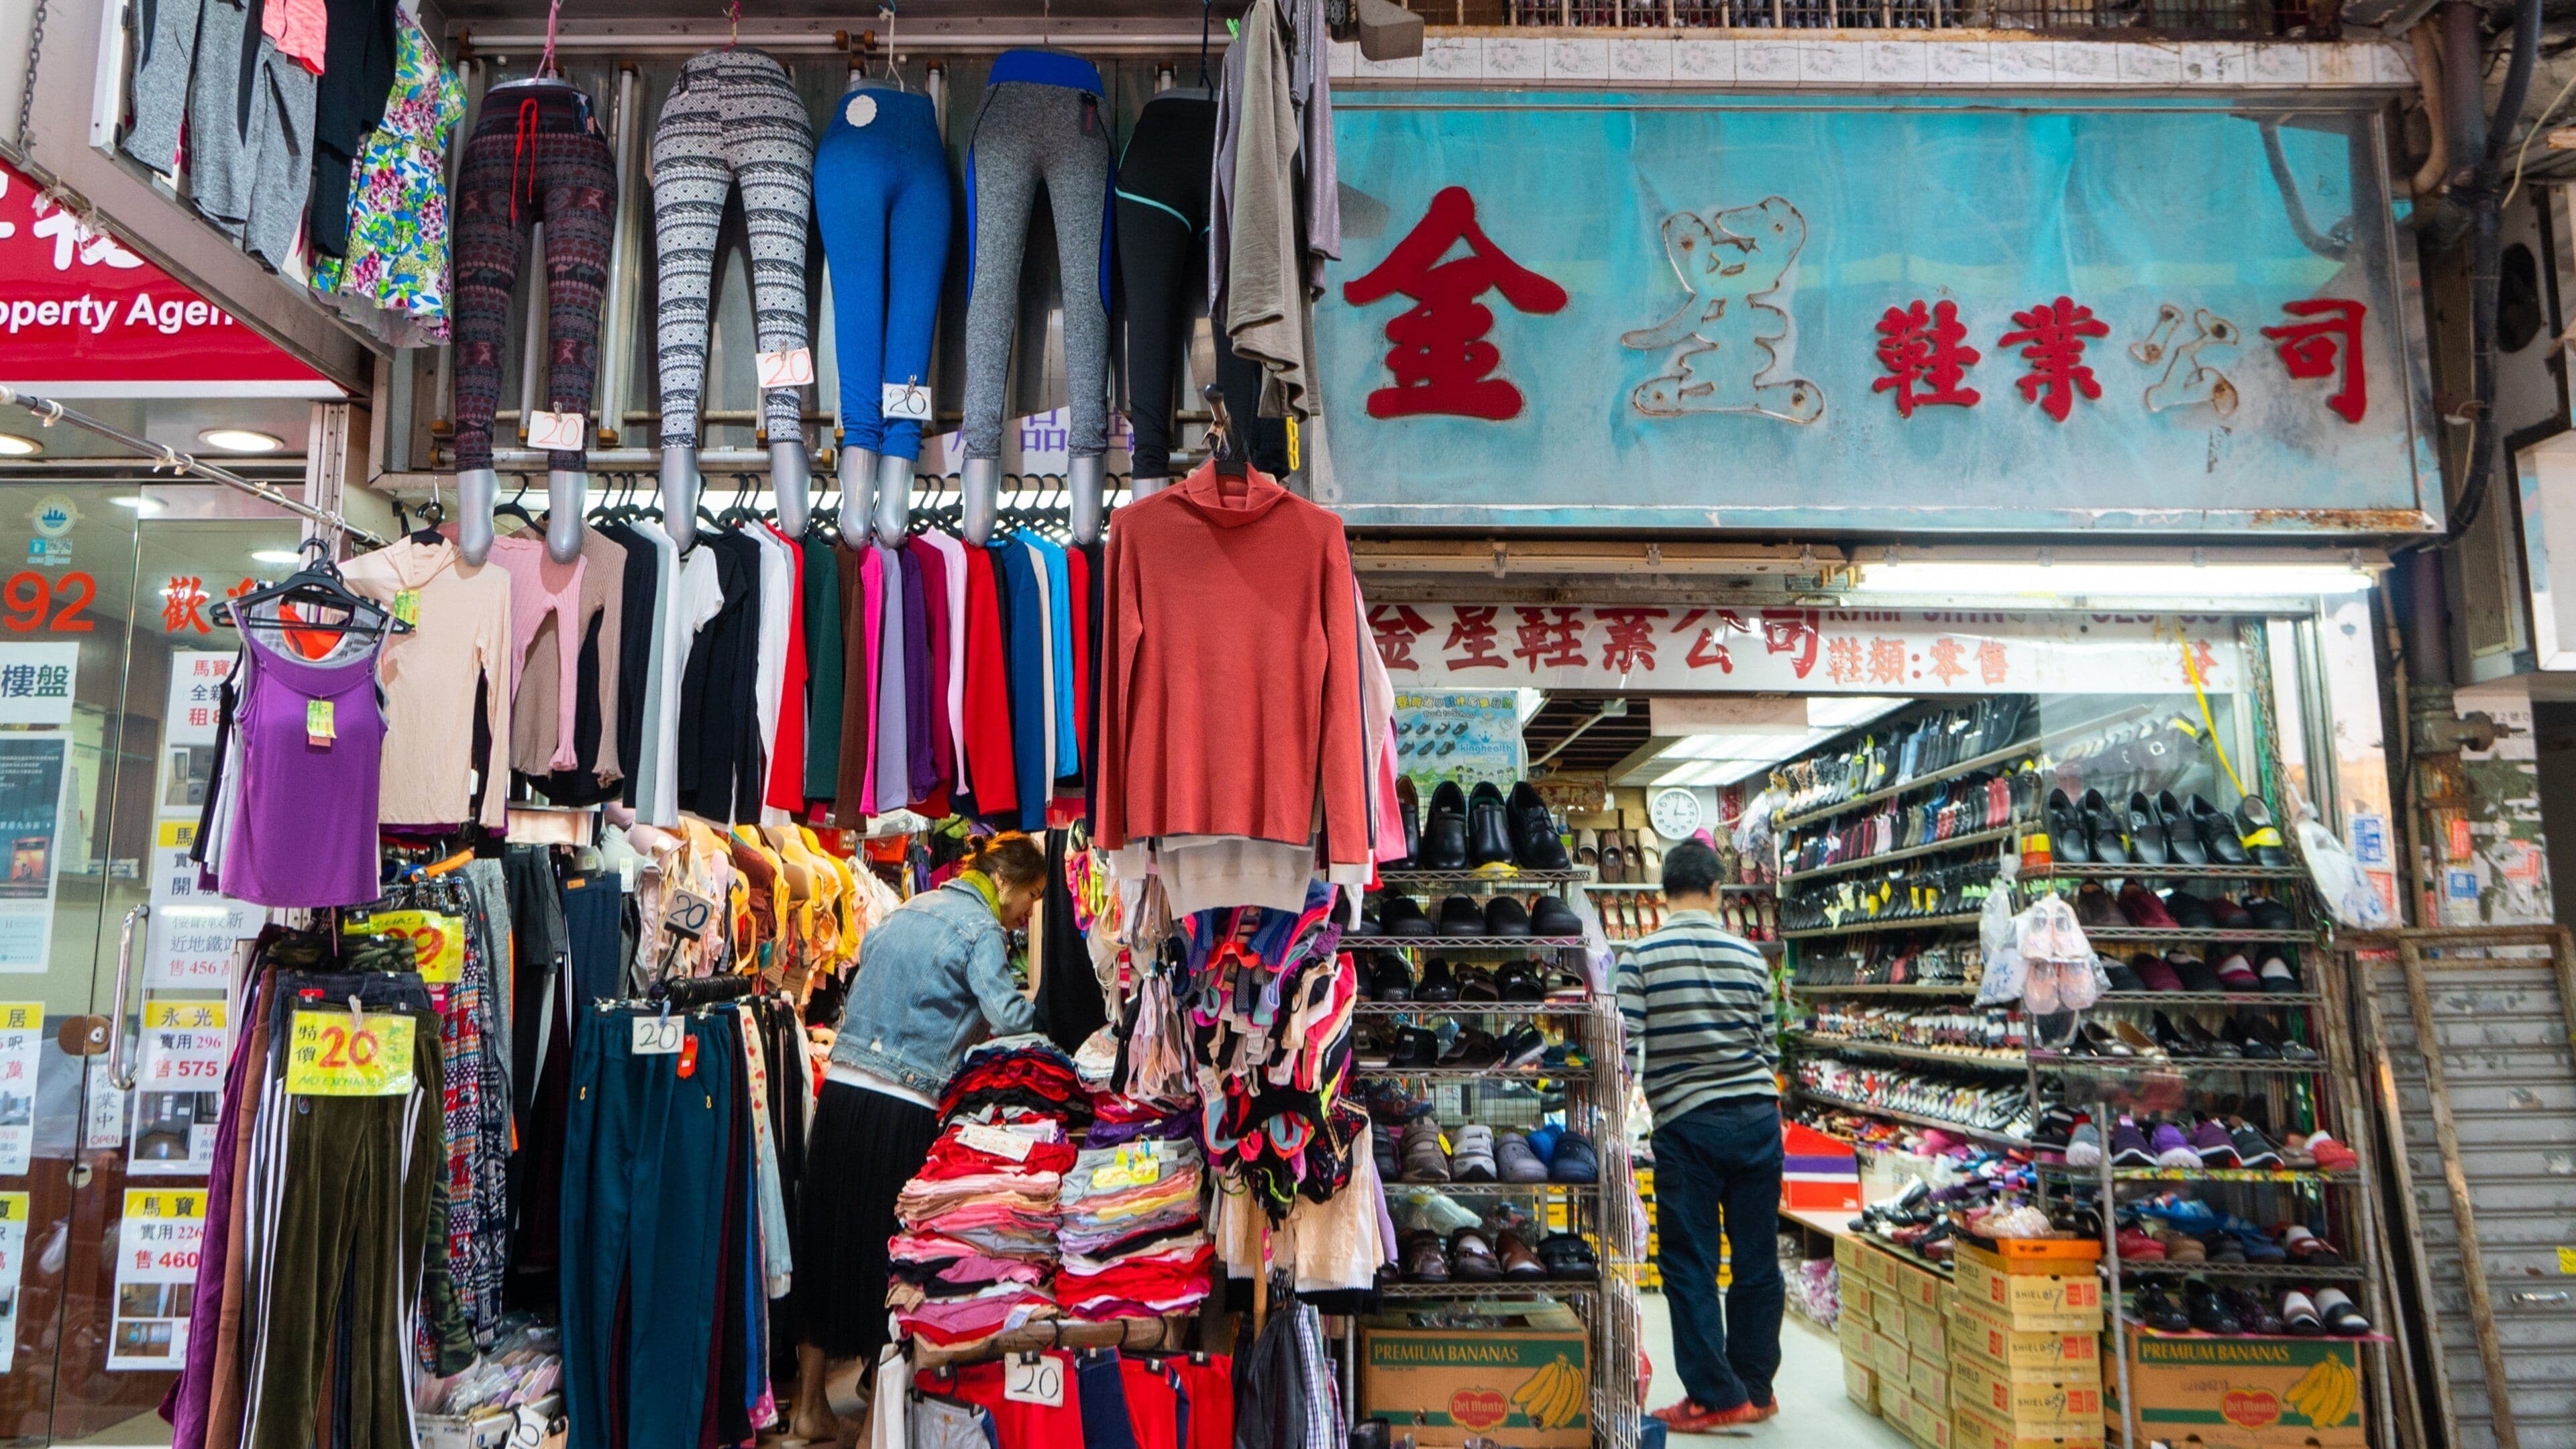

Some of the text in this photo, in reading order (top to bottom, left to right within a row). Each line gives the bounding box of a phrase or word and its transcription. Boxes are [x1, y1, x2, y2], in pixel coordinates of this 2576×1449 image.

[765, 352, 811, 385] 20
[890, 388, 926, 415] 20
[536, 415, 580, 447] 20
[3, 571, 97, 633] 92
[189, 708, 208, 727] 租
[1460, 744, 1512, 754] kinghealth
[175, 827, 194, 845] 馬
[670, 894, 708, 930] 20
[189, 961, 217, 974] 456
[7, 1009, 26, 1028] 居
[161, 1007, 213, 1027] 永光
[197, 1035, 222, 1049] 296
[639, 1023, 678, 1050] 20
[178, 1061, 218, 1077] 575
[91, 1134, 119, 1145] OPEN
[143, 1196, 195, 1218] 馬寶
[177, 1227, 204, 1240] 226
[158, 1252, 199, 1269] 460
[1375, 1344, 1519, 1362] PREMIUM BANANAS
[2143, 1342, 2290, 1362] PREMIUM BANANAS
[1012, 1363, 1059, 1399] 20
[1454, 1399, 1504, 1413] Del Monte
